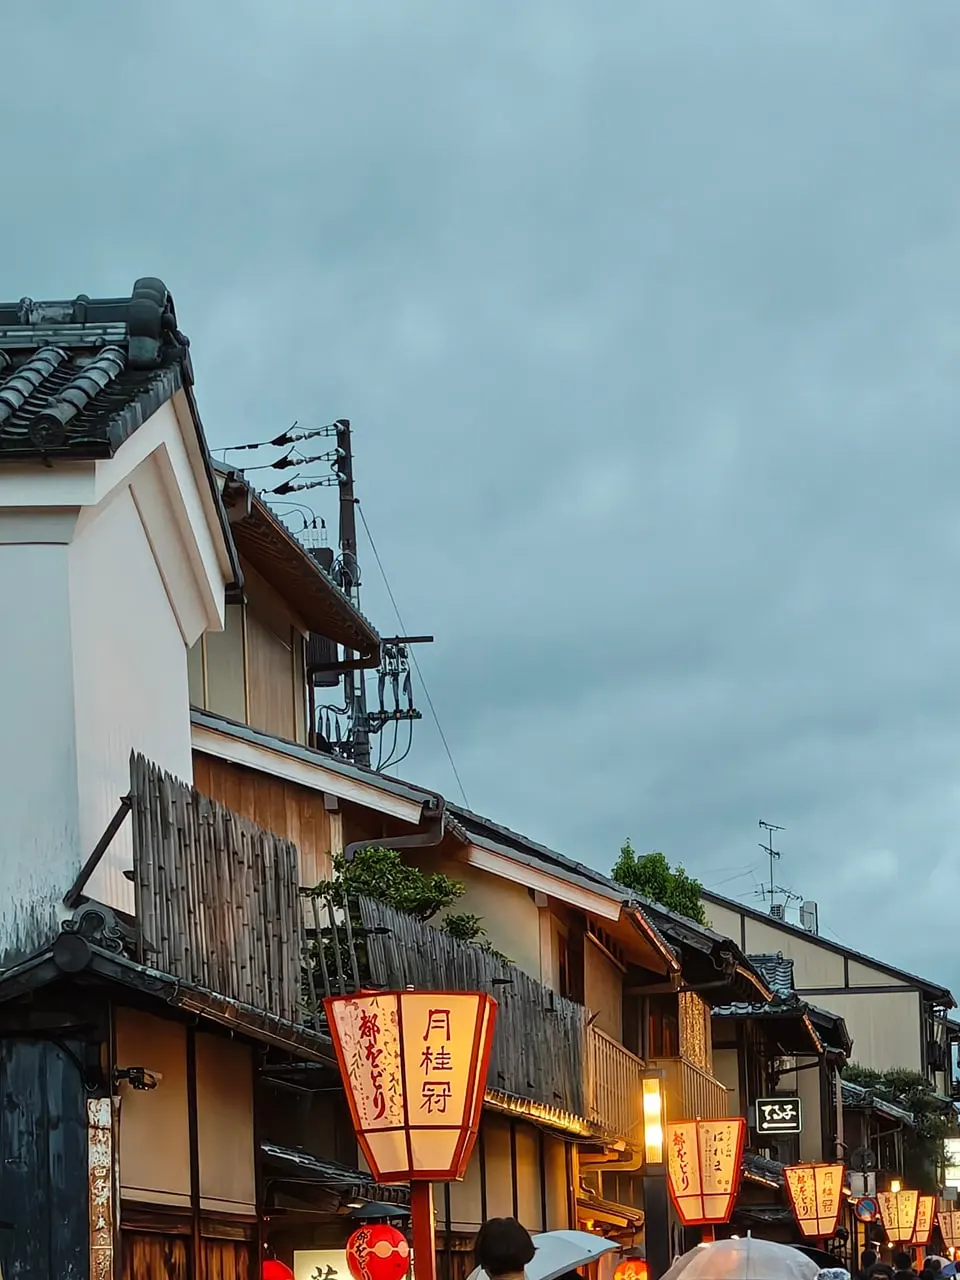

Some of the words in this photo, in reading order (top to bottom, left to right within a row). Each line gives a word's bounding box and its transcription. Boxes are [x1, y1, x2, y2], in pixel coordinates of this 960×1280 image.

[359, 1009, 387, 1121] 都をどり
[420, 1009, 453, 1114] 月桂冠
[761, 1104, 797, 1121] てる子
